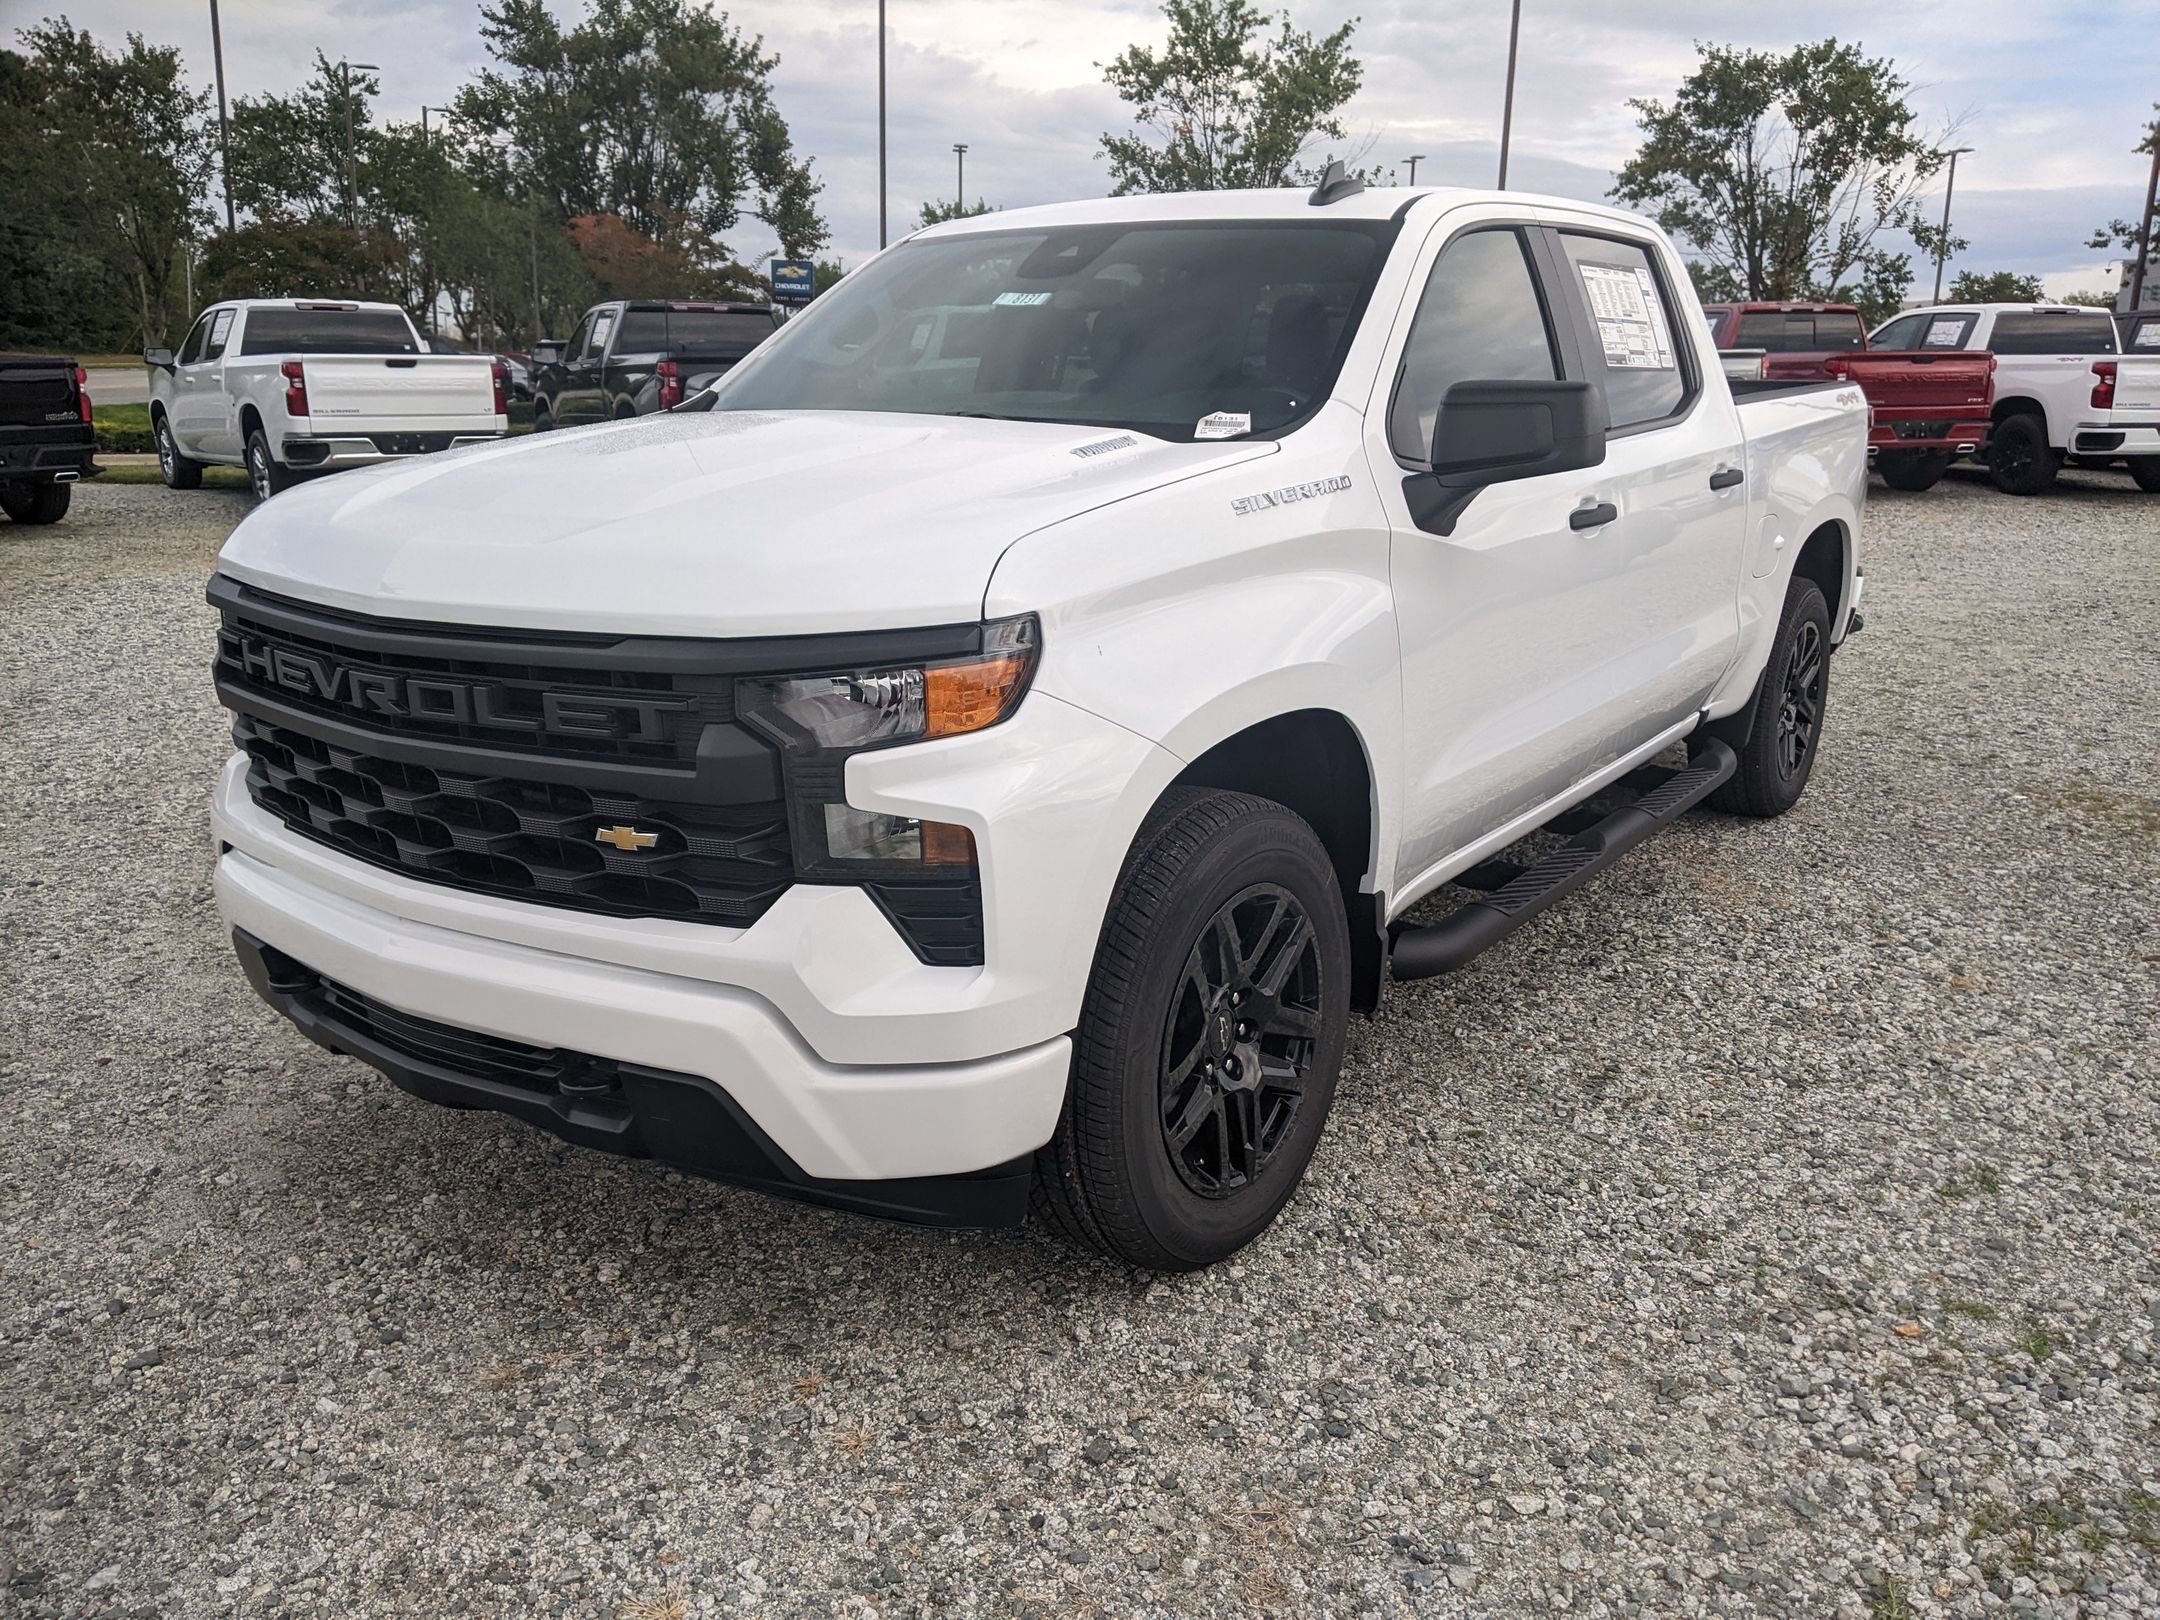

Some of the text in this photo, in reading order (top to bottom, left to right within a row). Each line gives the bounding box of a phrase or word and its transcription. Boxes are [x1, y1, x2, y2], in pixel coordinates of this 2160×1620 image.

[774, 282, 810, 290] CHEVROLET
[1231, 474, 1352, 516] SILVERADO
[218, 625, 698, 743] CHEVROLET
